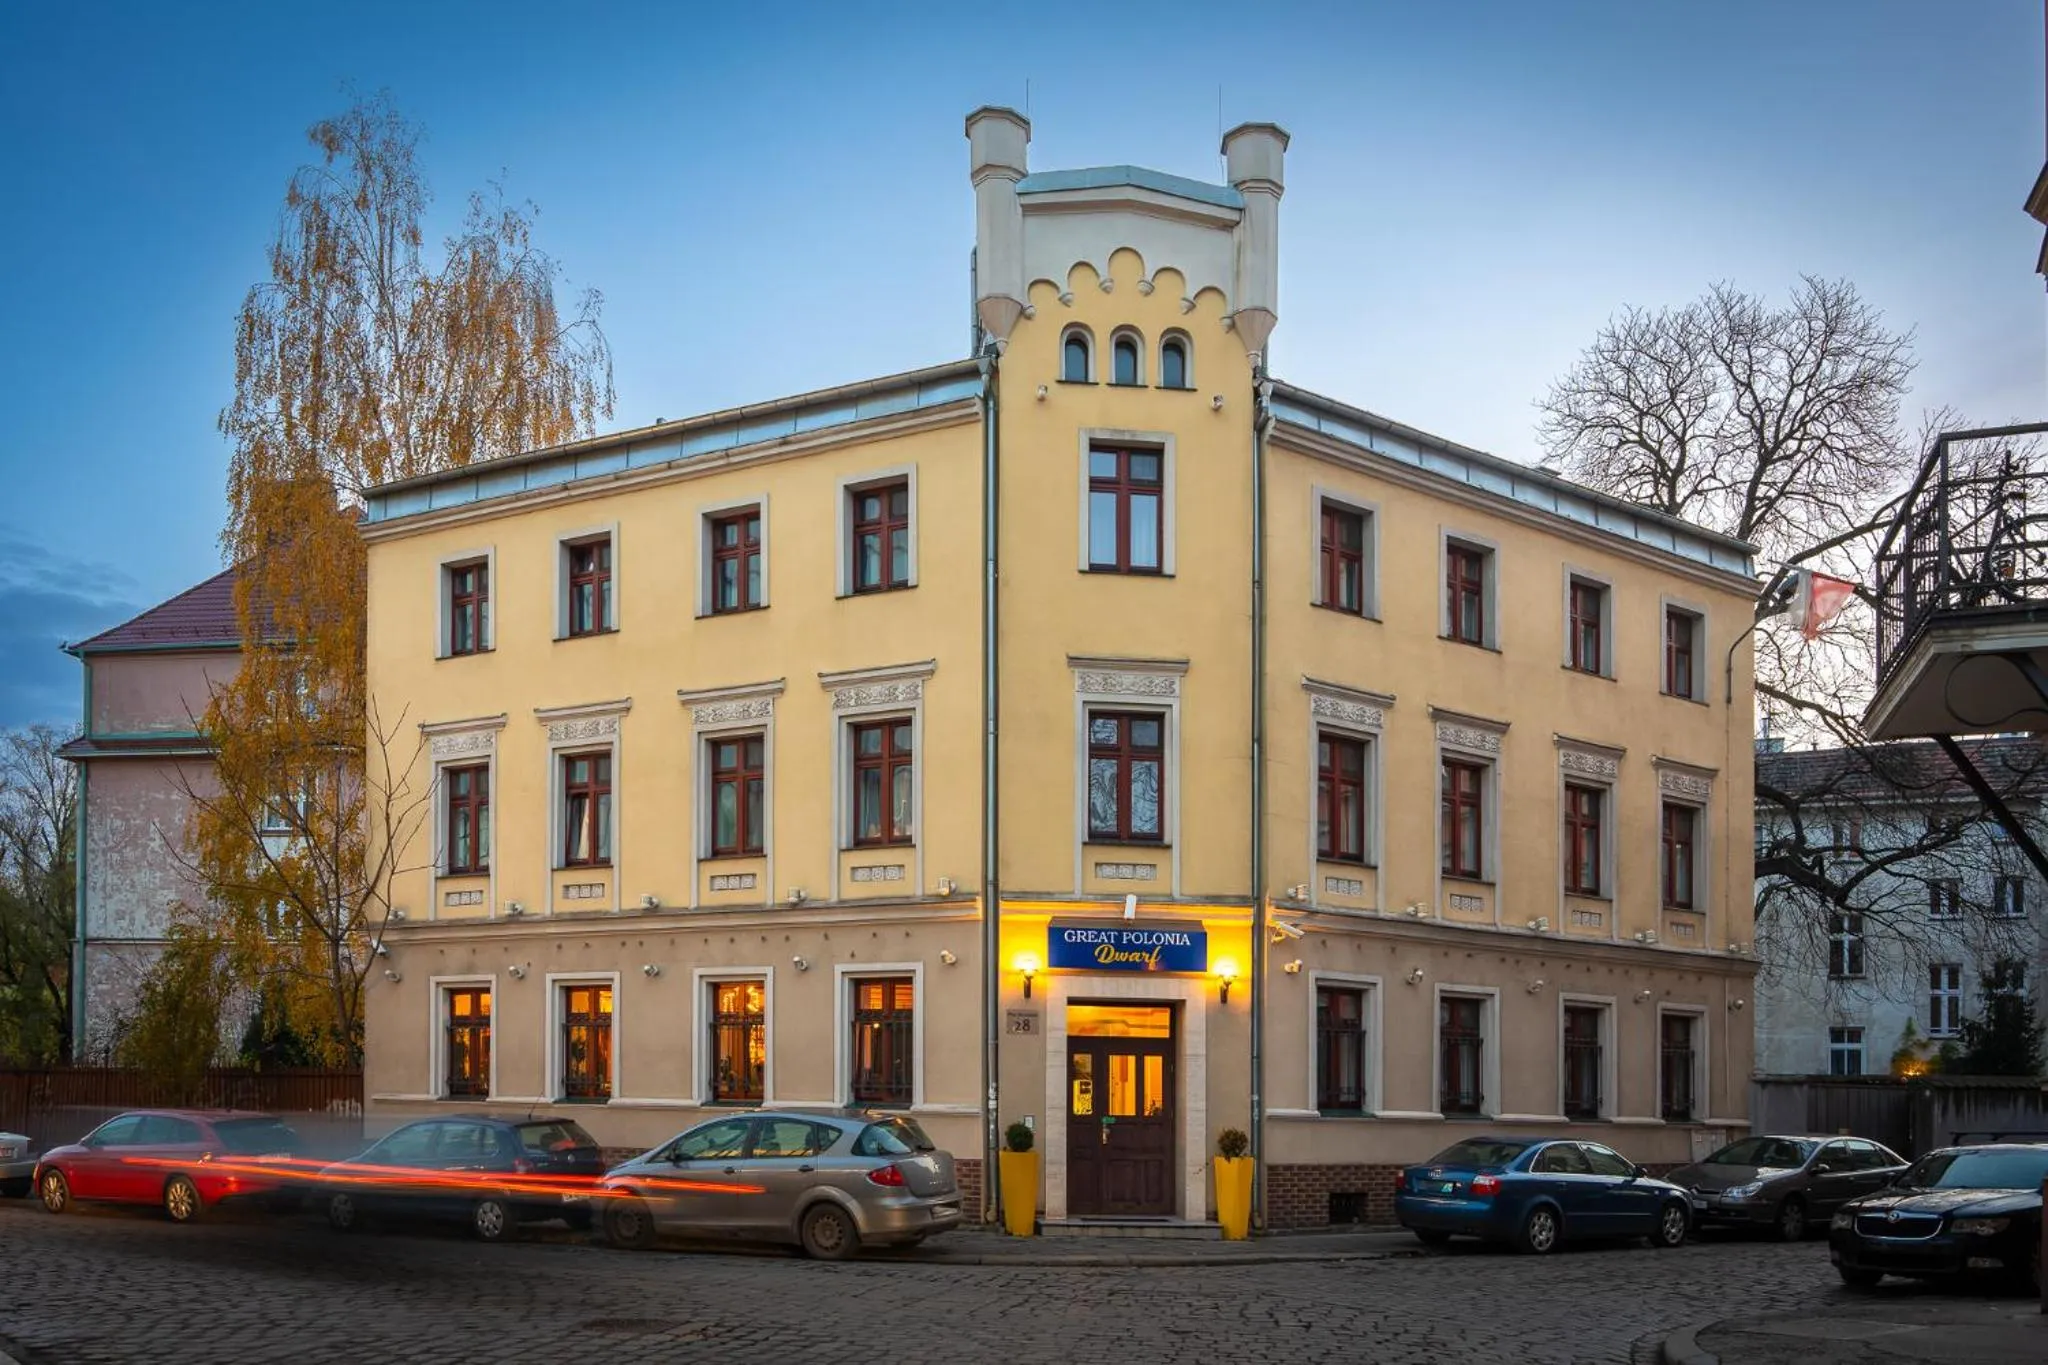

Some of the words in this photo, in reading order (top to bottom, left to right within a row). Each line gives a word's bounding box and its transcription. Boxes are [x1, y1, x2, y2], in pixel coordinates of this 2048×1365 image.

[1064, 929, 1118, 943] GREAT
[1122, 931, 1191, 945] POLONIA
[1094, 944, 1161, 971] Dwarf
[1014, 1019, 1031, 1032] 28
